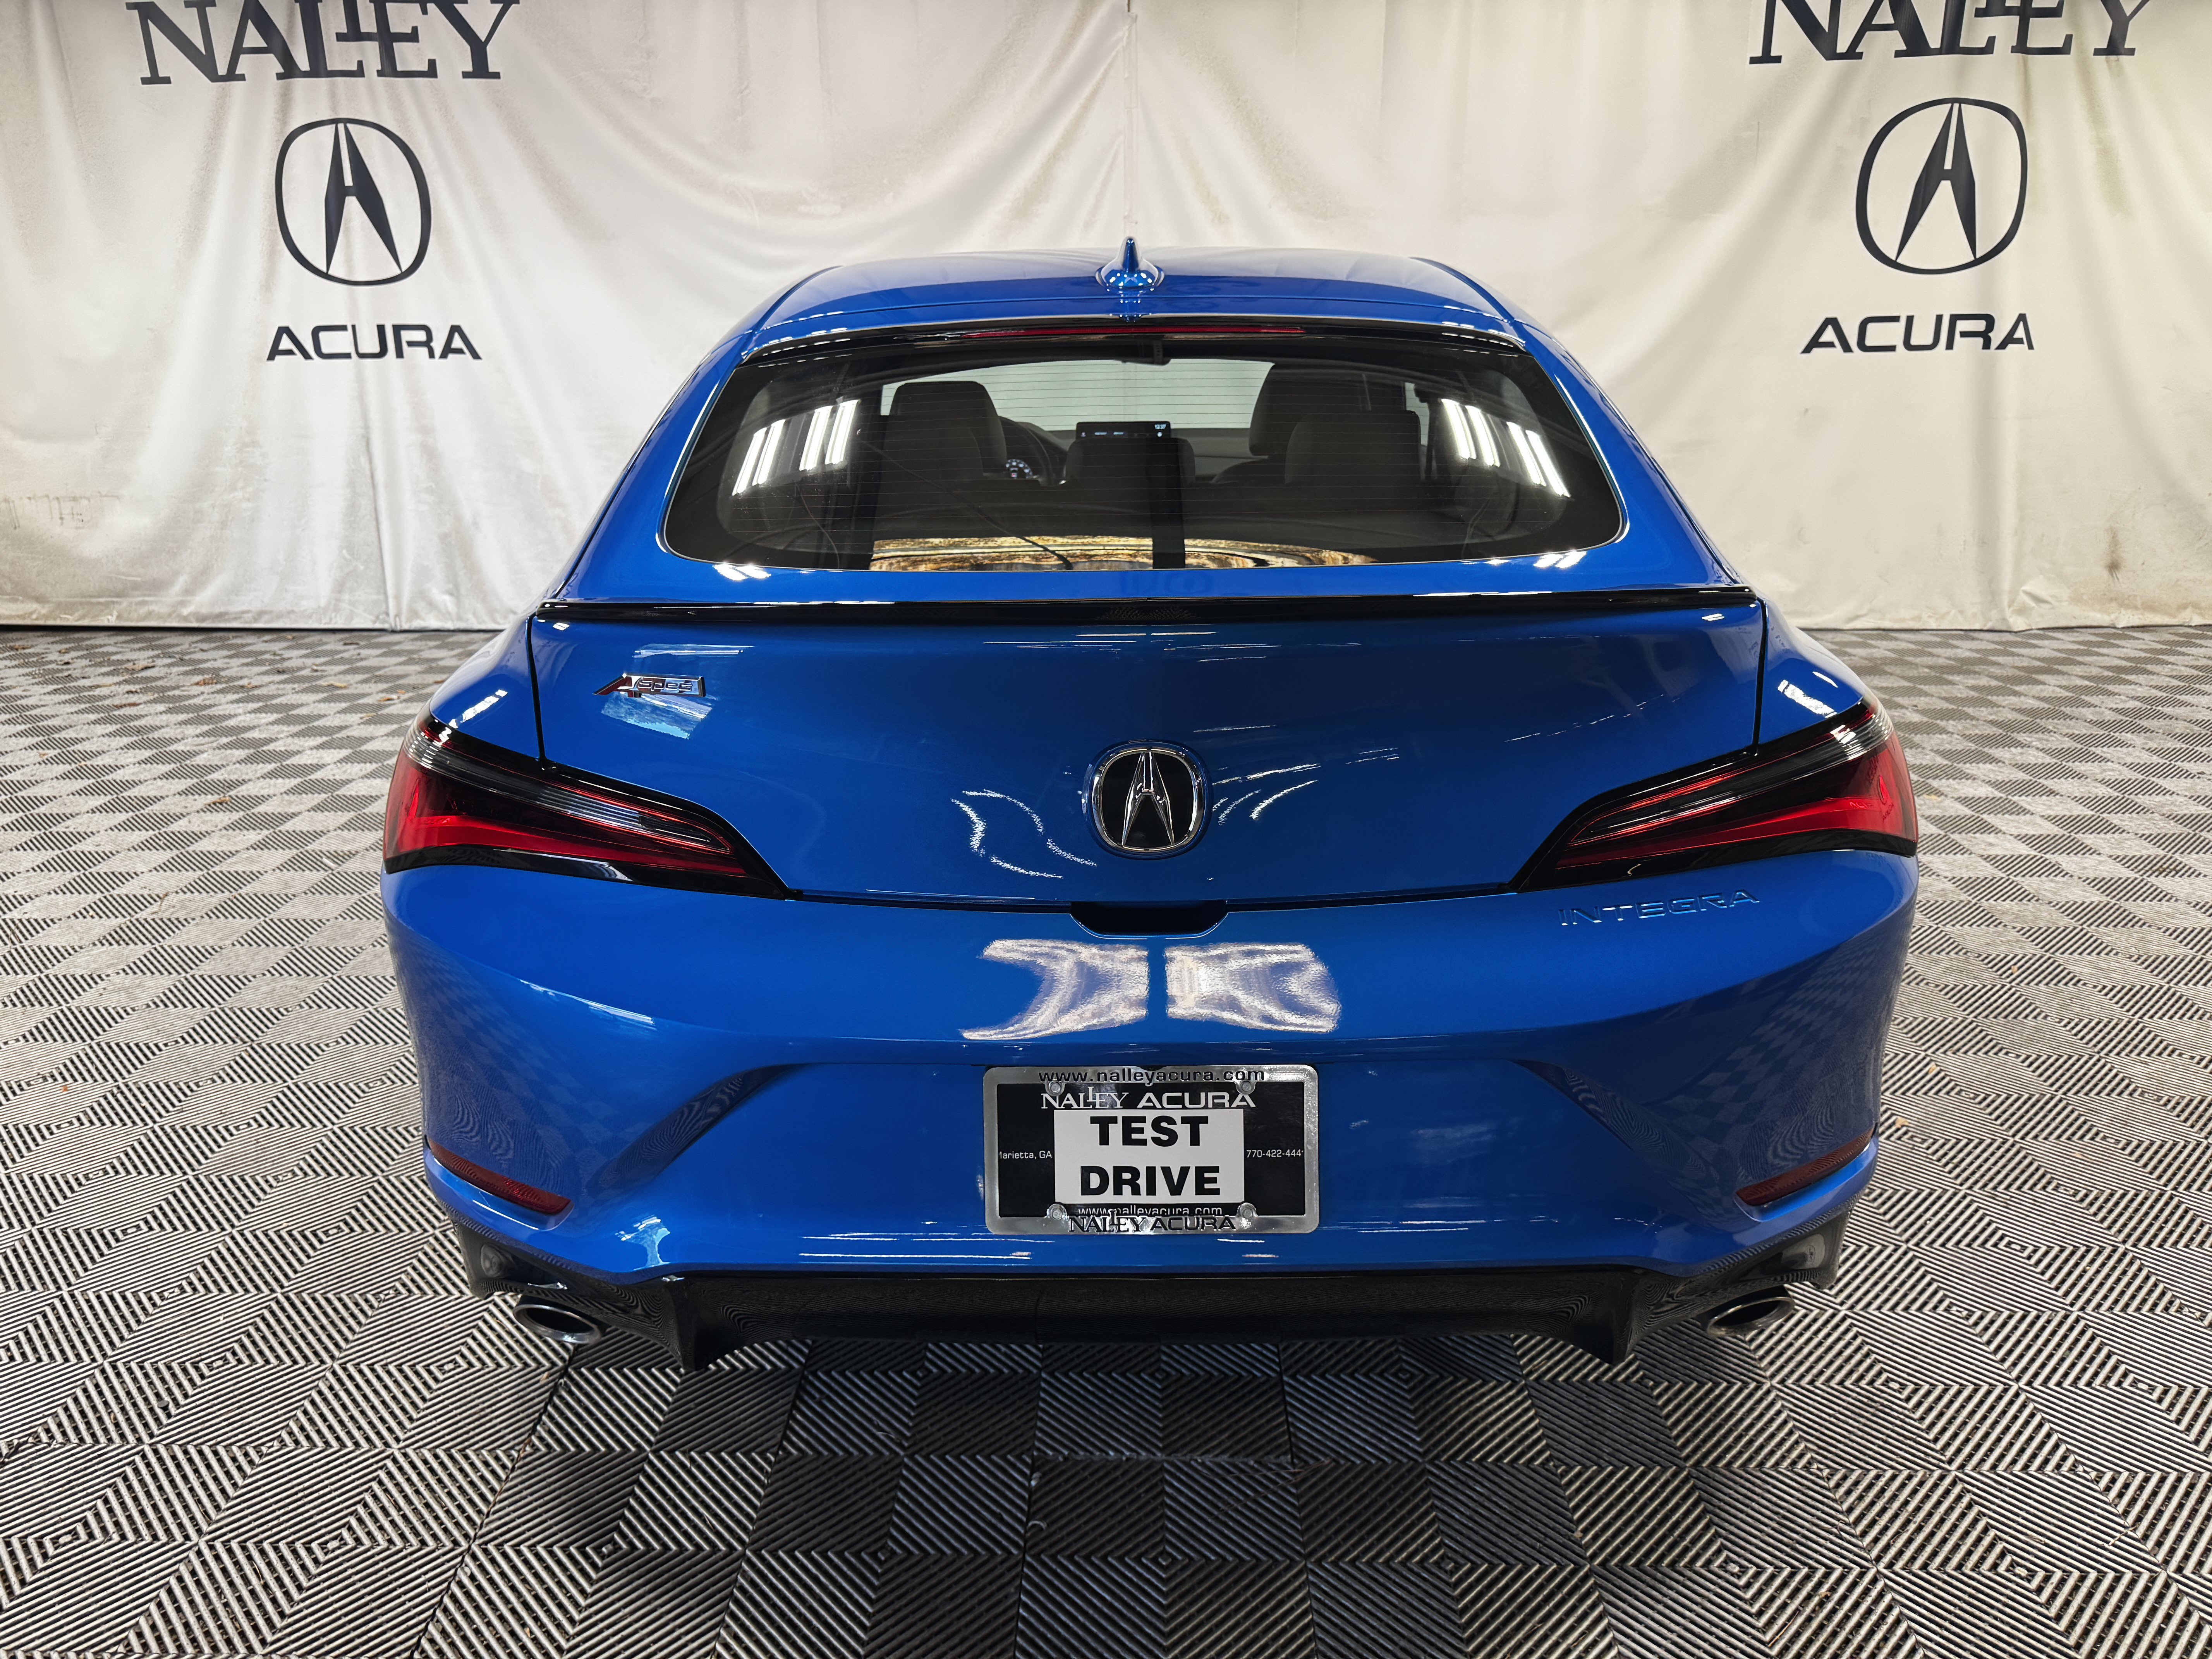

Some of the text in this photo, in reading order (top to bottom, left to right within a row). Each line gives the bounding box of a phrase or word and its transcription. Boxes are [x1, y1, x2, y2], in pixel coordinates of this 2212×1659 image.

[1749, 0, 2150, 64] NALEY
[267, 324, 483, 361] ACURA
[1800, 313, 2035, 354] ACURA
[1558, 889, 1760, 926] INTEGRA
[1039, 1068, 1265, 1085] www.nalleyacura.com
[1041, 1086, 1256, 1109] NALLEY ACURA
[1090, 1115, 1209, 1147] TEST
[1246, 1149, 1304, 1158] 770-422-444
[1080, 1166, 1221, 1196] DRIVE
[1069, 1209, 1237, 1232] NALLEY ACURA
